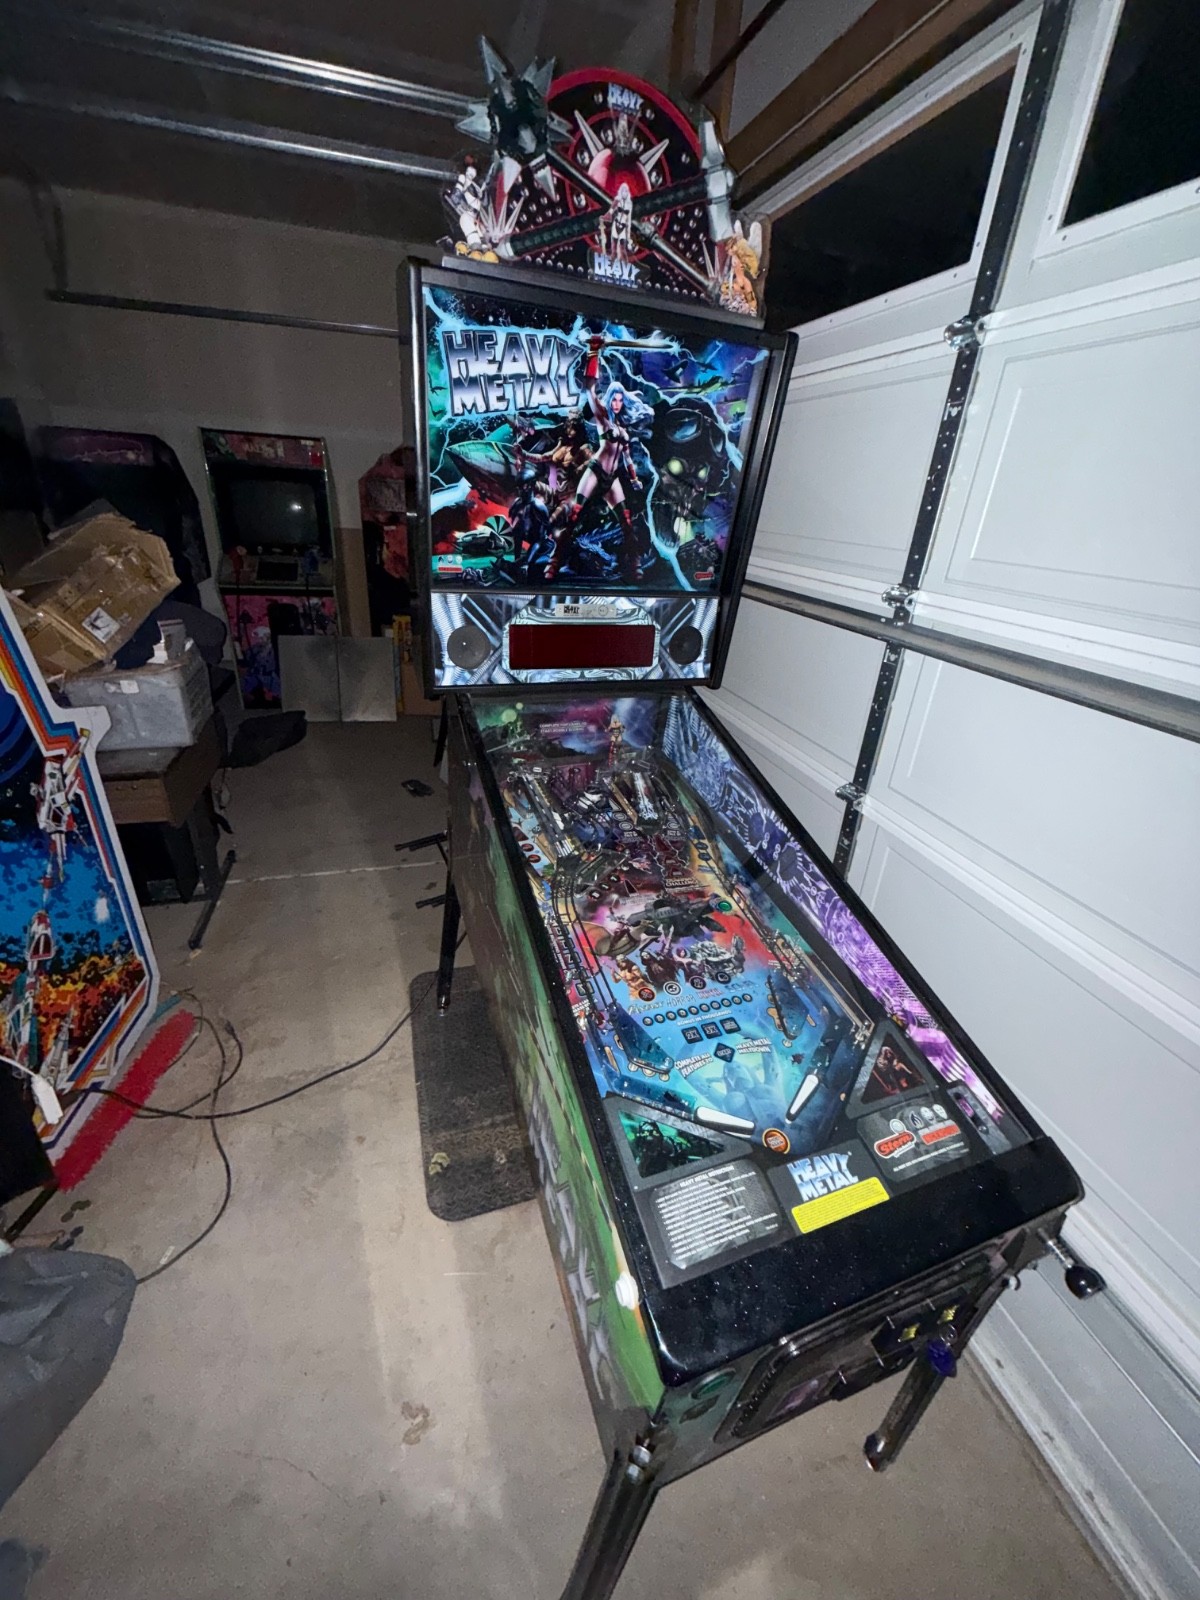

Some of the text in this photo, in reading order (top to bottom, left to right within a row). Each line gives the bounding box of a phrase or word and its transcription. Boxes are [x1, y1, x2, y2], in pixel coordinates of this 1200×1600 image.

[608, 82, 644, 110] HEAVY
[594, 252, 640, 281] HEAVY
[442, 329, 586, 378] HEAVY
[451, 373, 580, 417] METAL
[674, 1054, 701, 1070] COMPLETE
[681, 1059, 705, 1078] FEATURES
[879, 1132, 914, 1154] Stern
[786, 1152, 850, 1184] HEAVY
[797, 1170, 859, 1203] METAL
